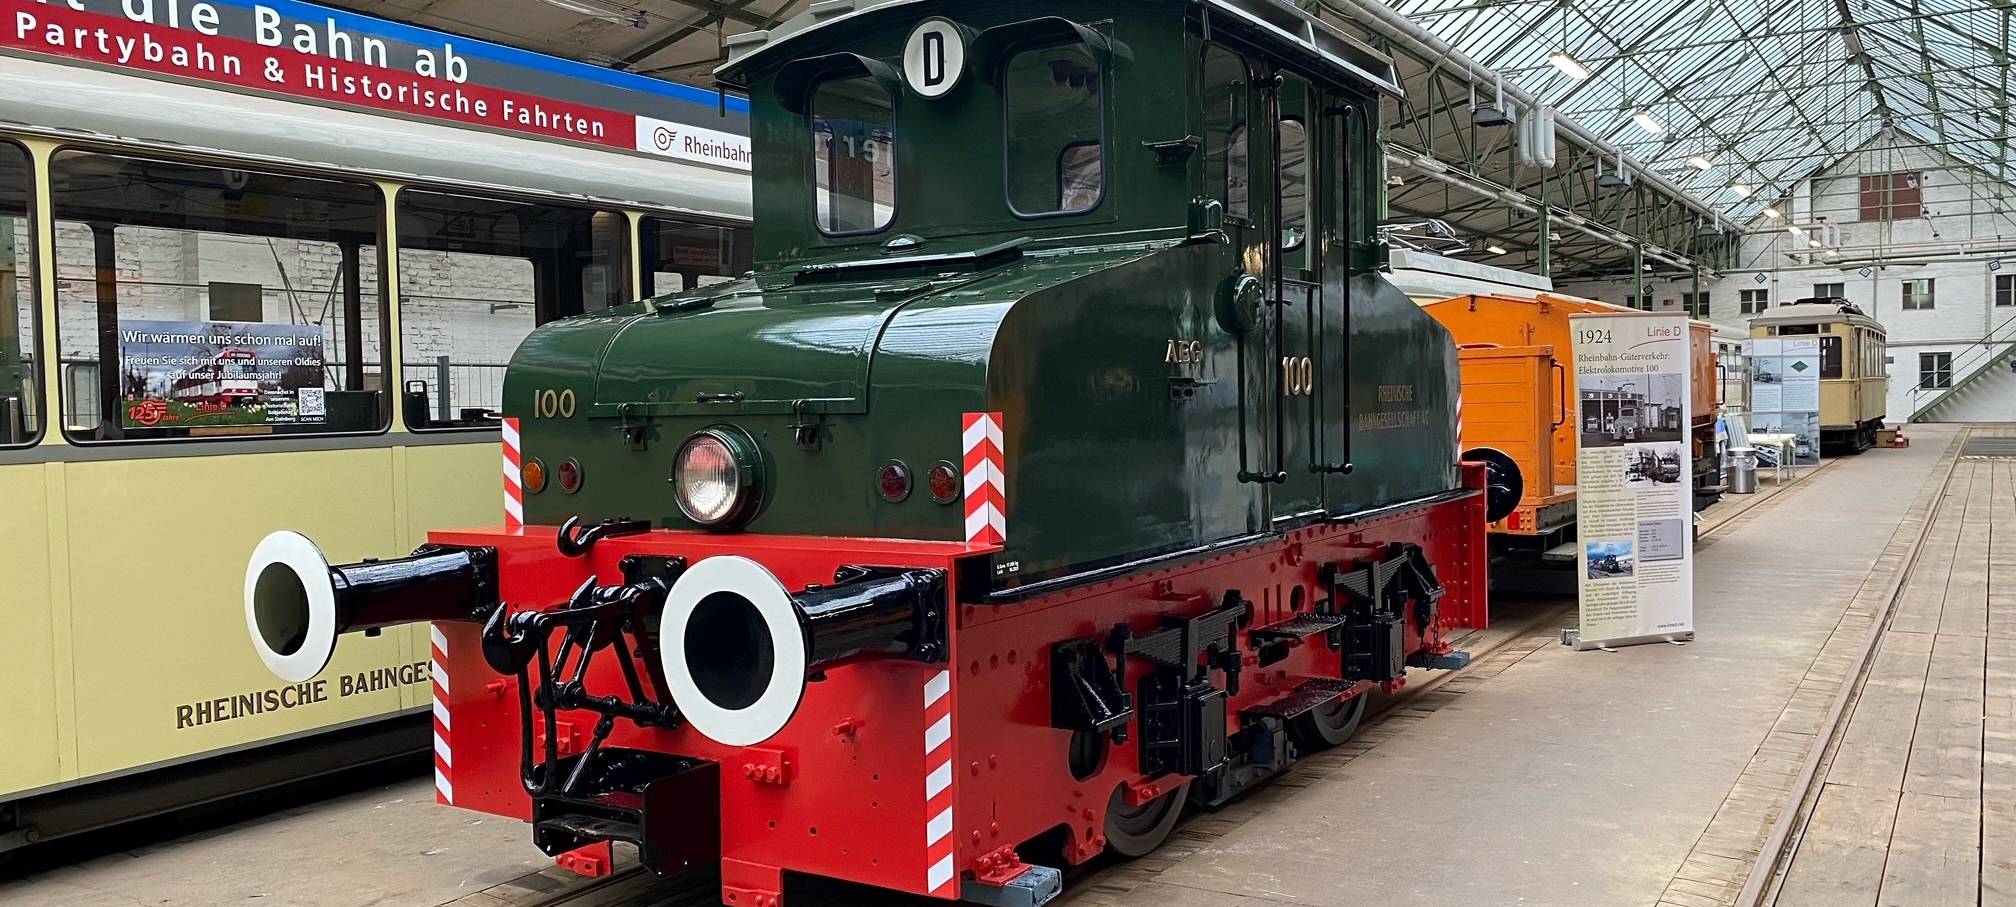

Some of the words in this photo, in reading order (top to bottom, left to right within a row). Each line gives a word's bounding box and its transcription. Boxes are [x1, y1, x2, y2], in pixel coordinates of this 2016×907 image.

[254, 4, 388, 69] Bahn
[414, 43, 468, 84] ab
[922, 30, 945, 88] D
[16, 11, 242, 76] Partybahn
[263, 56, 286, 84] &
[304, 63, 488, 117] Historische
[502, 99, 605, 138] Fahrten
[684, 135, 752, 164] Rheinbahn
[122, 330, 148, 343] Wir
[150, 331, 205, 345] wärmen
[208, 335, 232, 346] uns
[234, 333, 271, 346] schon
[274, 334, 296, 347] mal
[298, 335, 321, 347] auf!
[1578, 329, 1612, 345] 1924
[1647, 326, 1670, 337] Linie
[1673, 326, 1681, 337] D
[125, 355, 159, 366] Freuen
[162, 355, 177, 366] Sie
[179, 356, 198, 367] sich
[200, 356, 216, 367] mit
[218, 358, 236, 367] uns
[238, 356, 256, 367] und
[258, 358, 293, 367] unseren
[294, 356, 321, 367] Oldies
[1165, 339, 1200, 363] AEG
[1578, 351, 1671, 363] Rheinbahn-Güterverkehr:
[170, 369, 187, 380] auf
[188, 371, 215, 380] unser
[217, 370, 282, 382] Jubiläumsjahr!
[1282, 356, 1313, 396] 100
[1578, 366, 1644, 375] Elektrolokomotive
[1646, 364, 1659, 374] 100
[534, 388, 576, 418] 100
[1378, 384, 1413, 402] RHEINISCHE
[175, 679, 328, 730] RHEINISCHE
